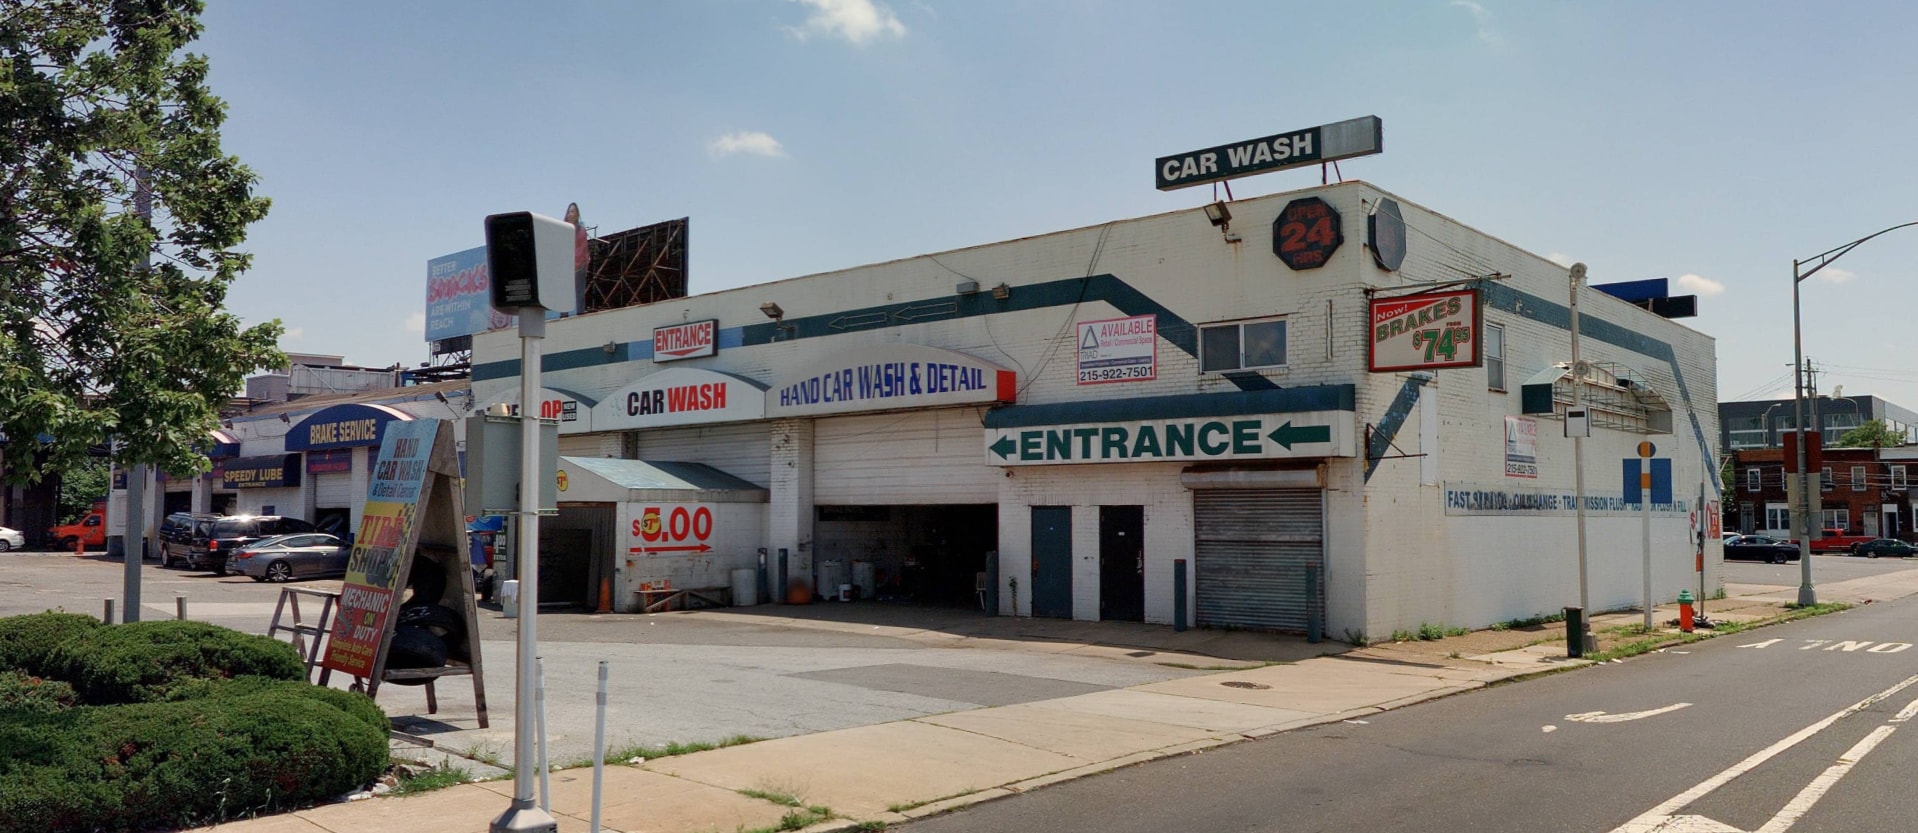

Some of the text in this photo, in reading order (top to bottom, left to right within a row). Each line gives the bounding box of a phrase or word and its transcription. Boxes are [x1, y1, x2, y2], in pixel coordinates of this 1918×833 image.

[1162, 133, 1313, 181] CAR WASH
[1287, 203, 1328, 220] OPEN
[1280, 216, 1336, 253] 24
[432, 262, 456, 276] BETTER
[429, 264, 488, 303] SNACKS
[431, 301, 471, 317] ARE WITHIN
[1376, 303, 1408, 322] Now!
[431, 318, 454, 331] REACH
[1101, 320, 1153, 338] AVAILABLE
[1376, 296, 1462, 343] BRAKES
[655, 323, 711, 352] ENTRANCE
[780, 361, 987, 406] HAND CAR WASH & DETAIL
[1080, 366, 1153, 381] 215-922-7501
[627, 382, 727, 416] CAR WASH
[310, 419, 376, 445] BRAKE SERVICE
[1020, 420, 1263, 461] ENTRANCE
[393, 438, 419, 458] HAND
[224, 468, 283, 483] SPEEDY LUBE
[377, 460, 424, 480] CAR WASH
[1448, 490, 1471, 509] FAST
[358, 515, 404, 548] TIRE
[341, 587, 390, 613] MECHANIC
[364, 611, 376, 625] ON
[353, 625, 379, 642] DUTY
